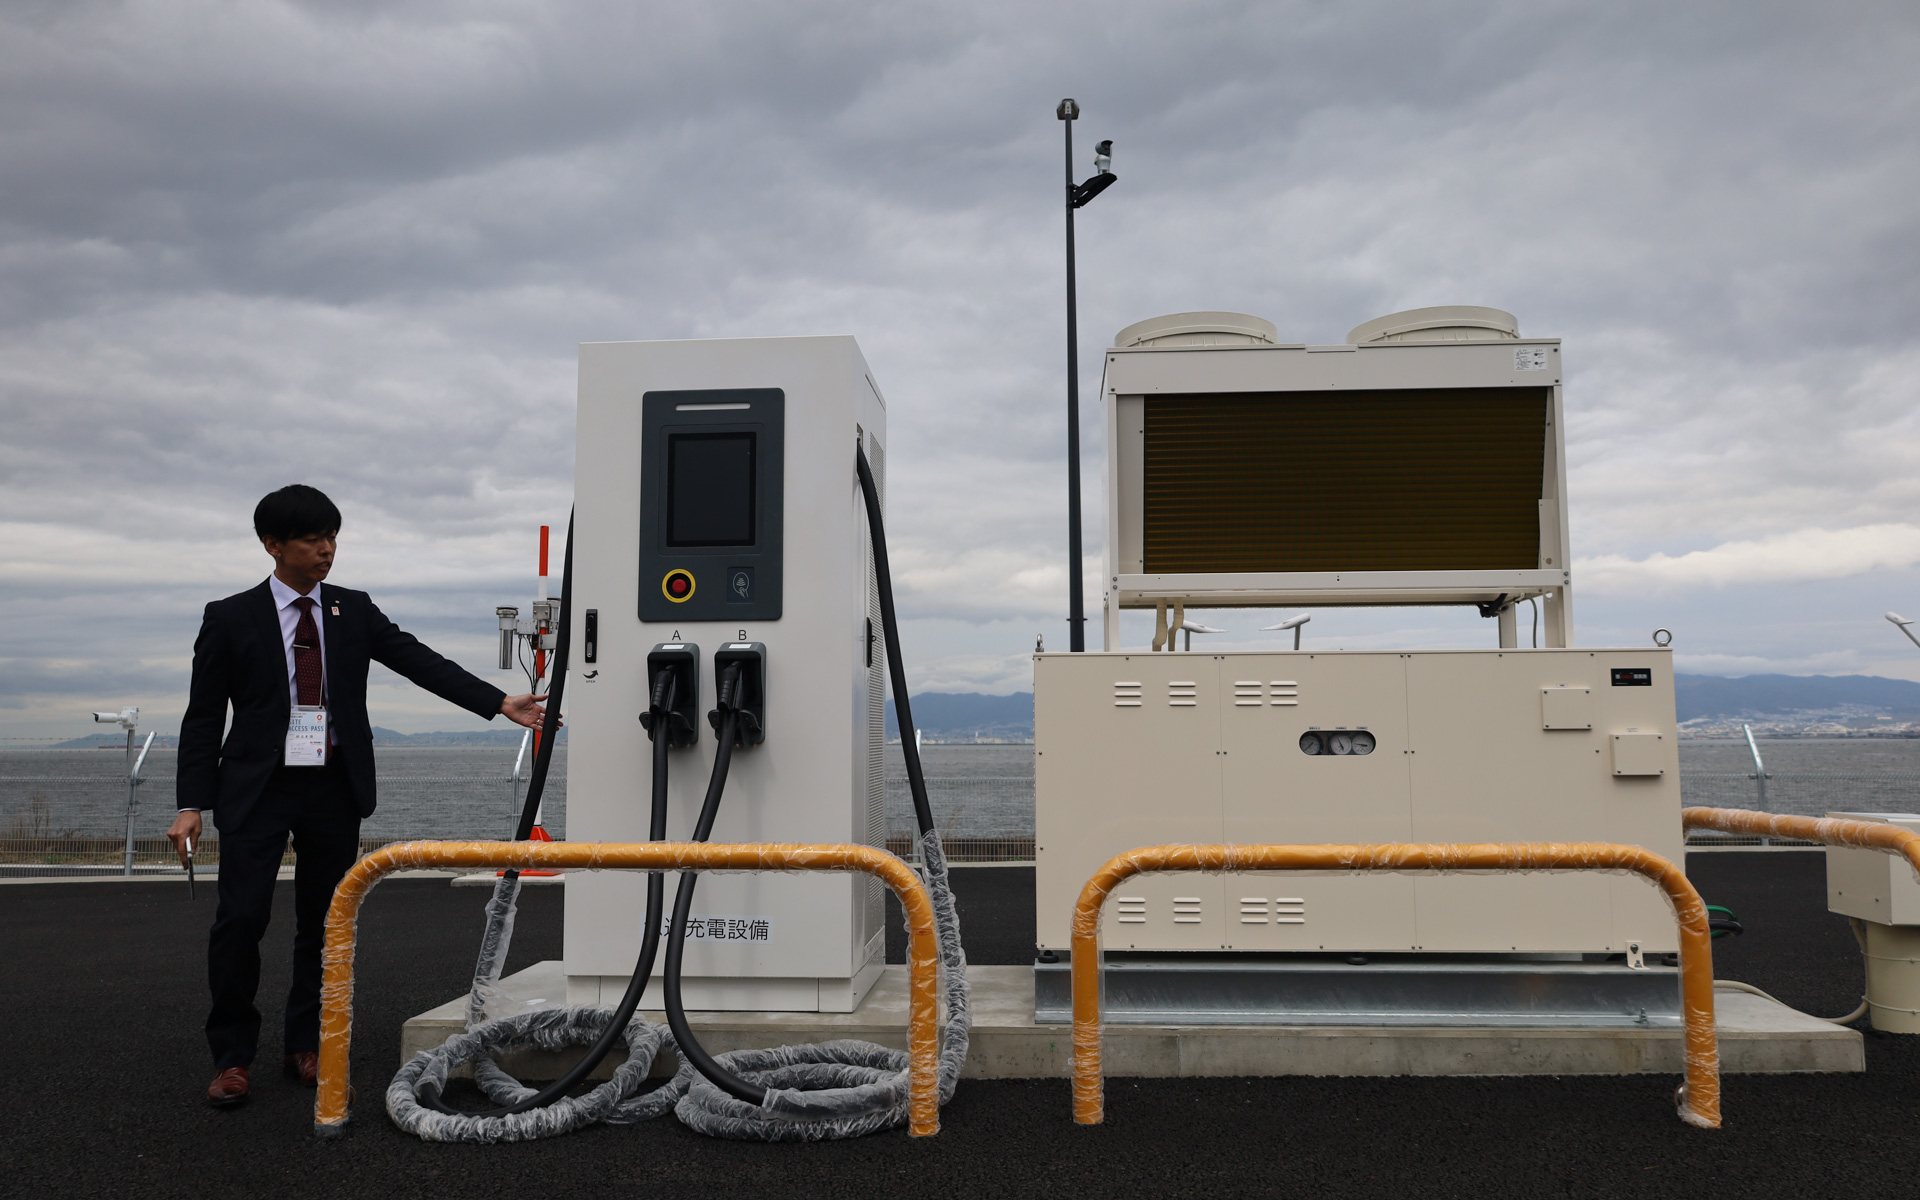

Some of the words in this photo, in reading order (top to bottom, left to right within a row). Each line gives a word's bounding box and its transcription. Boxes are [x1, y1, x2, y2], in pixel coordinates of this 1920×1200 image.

[671, 630, 682, 641] A
[738, 629, 747, 640] B
[644, 917, 770, 941] 充電設備
